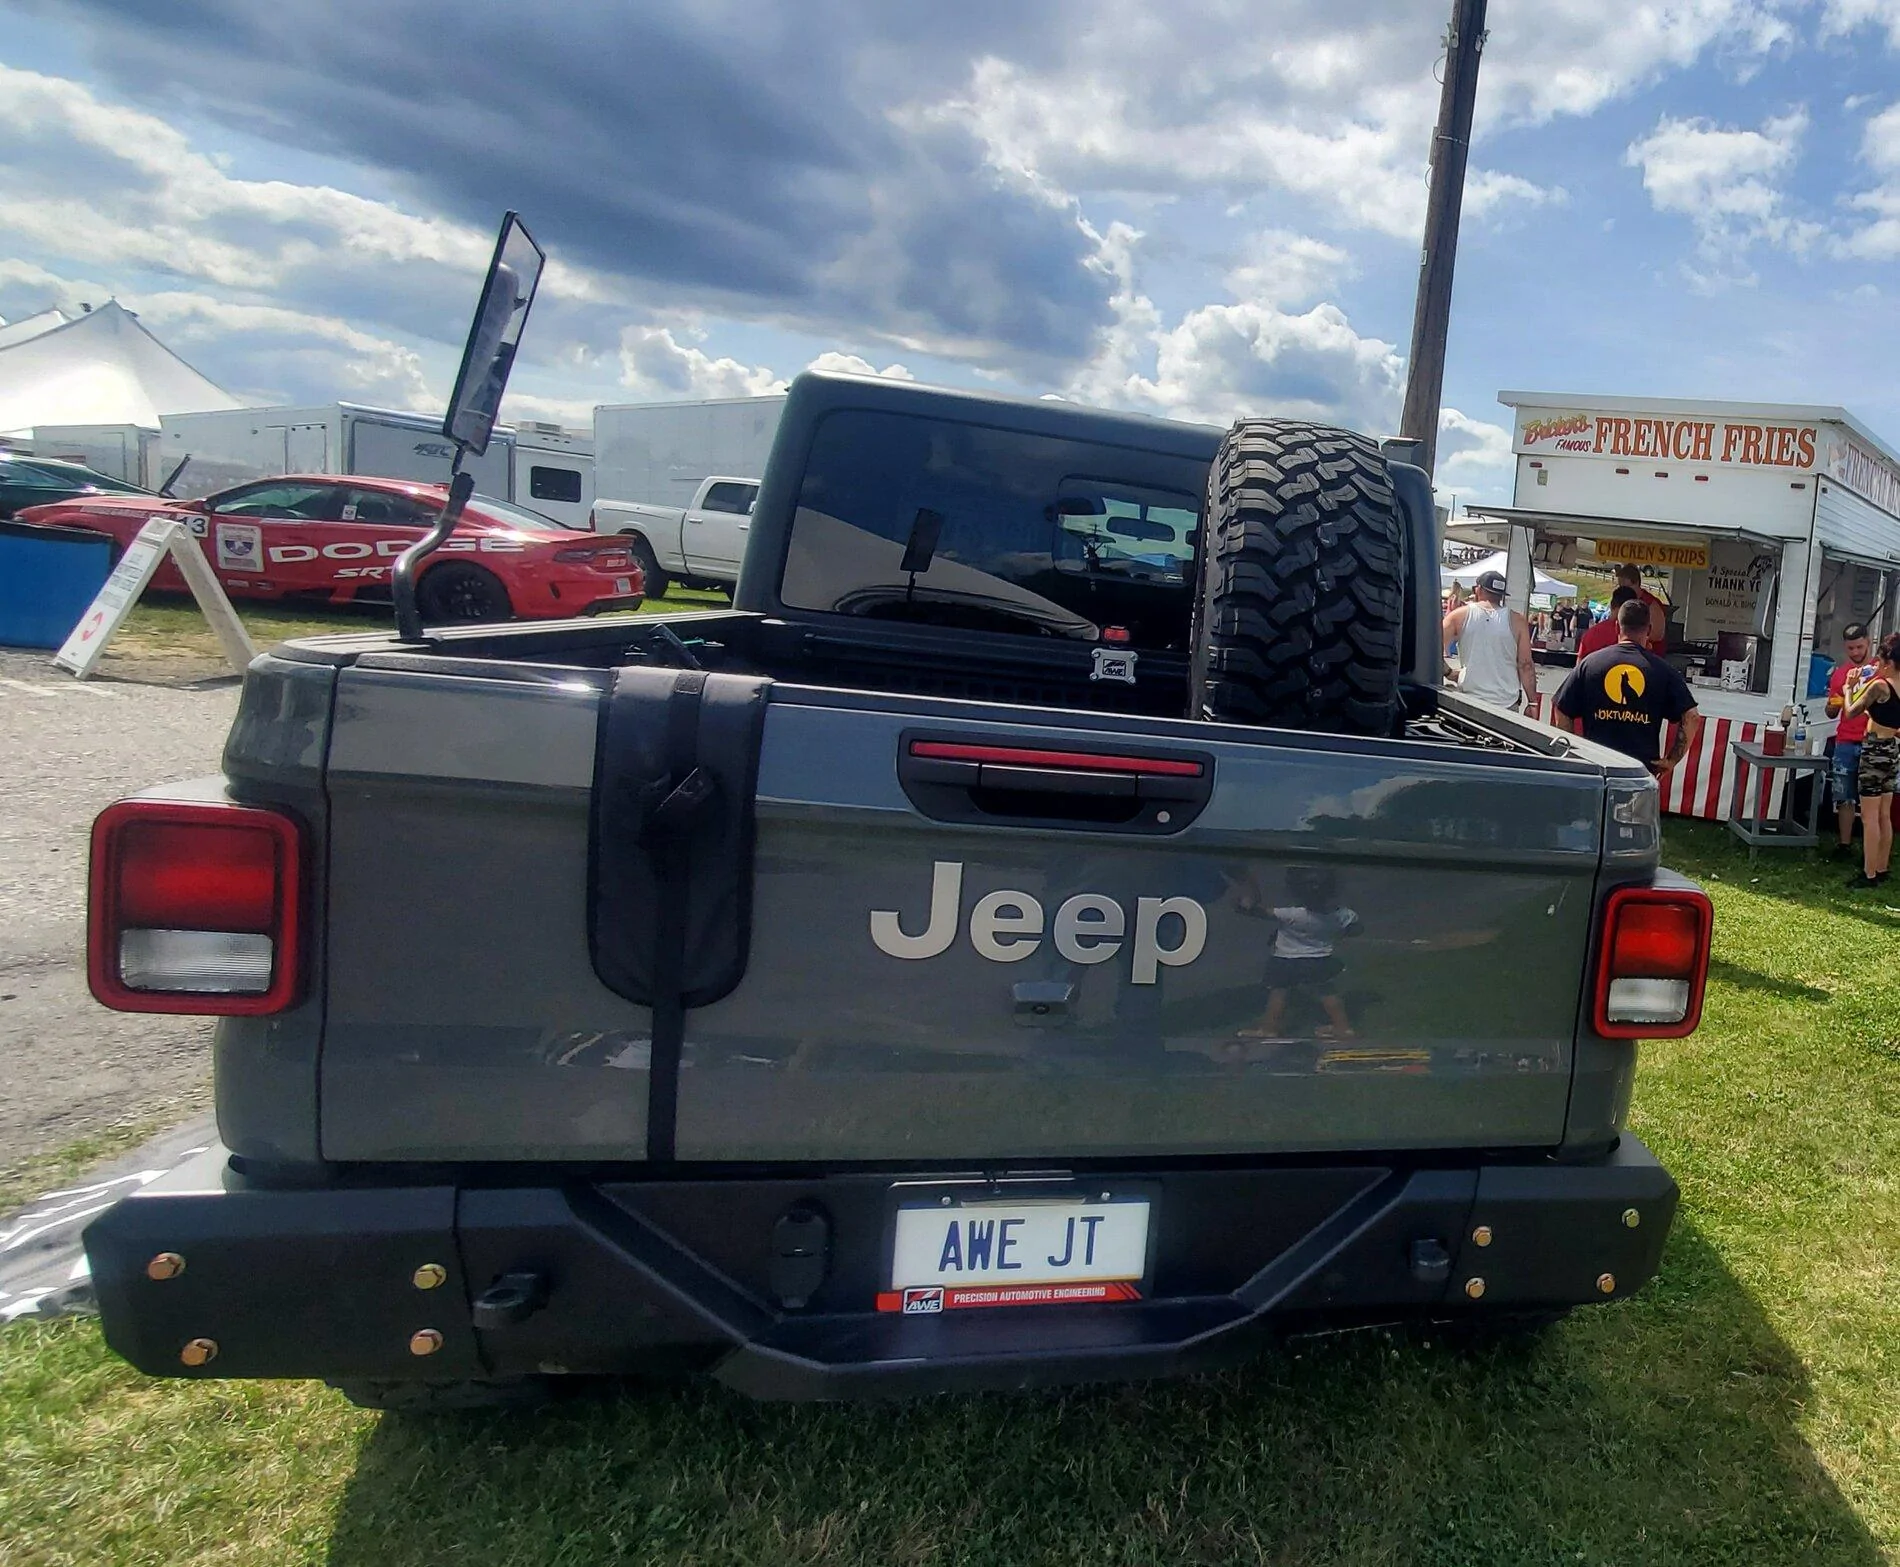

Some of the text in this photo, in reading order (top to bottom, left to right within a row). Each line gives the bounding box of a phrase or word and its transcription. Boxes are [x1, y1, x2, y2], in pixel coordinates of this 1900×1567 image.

[1555, 439, 1591, 452] FAMOUS
[1593, 417, 1817, 468] FRENCH FRIES
[269, 538, 524, 563] DODGE
[1600, 541, 1705, 565] CHICKEN STRIPS
[1720, 566, 1749, 577] Special
[1708, 577, 1745, 591] THANK
[1594, 709, 1651, 724] NOKTURNAL
[870, 861, 1207, 984] Jeep
[939, 1216, 1105, 1271] AWE JT
[954, 1286, 1106, 1304] PRECISION AUTOMOTIVE ENGINEERING
[907, 1300, 939, 1311] AWE
